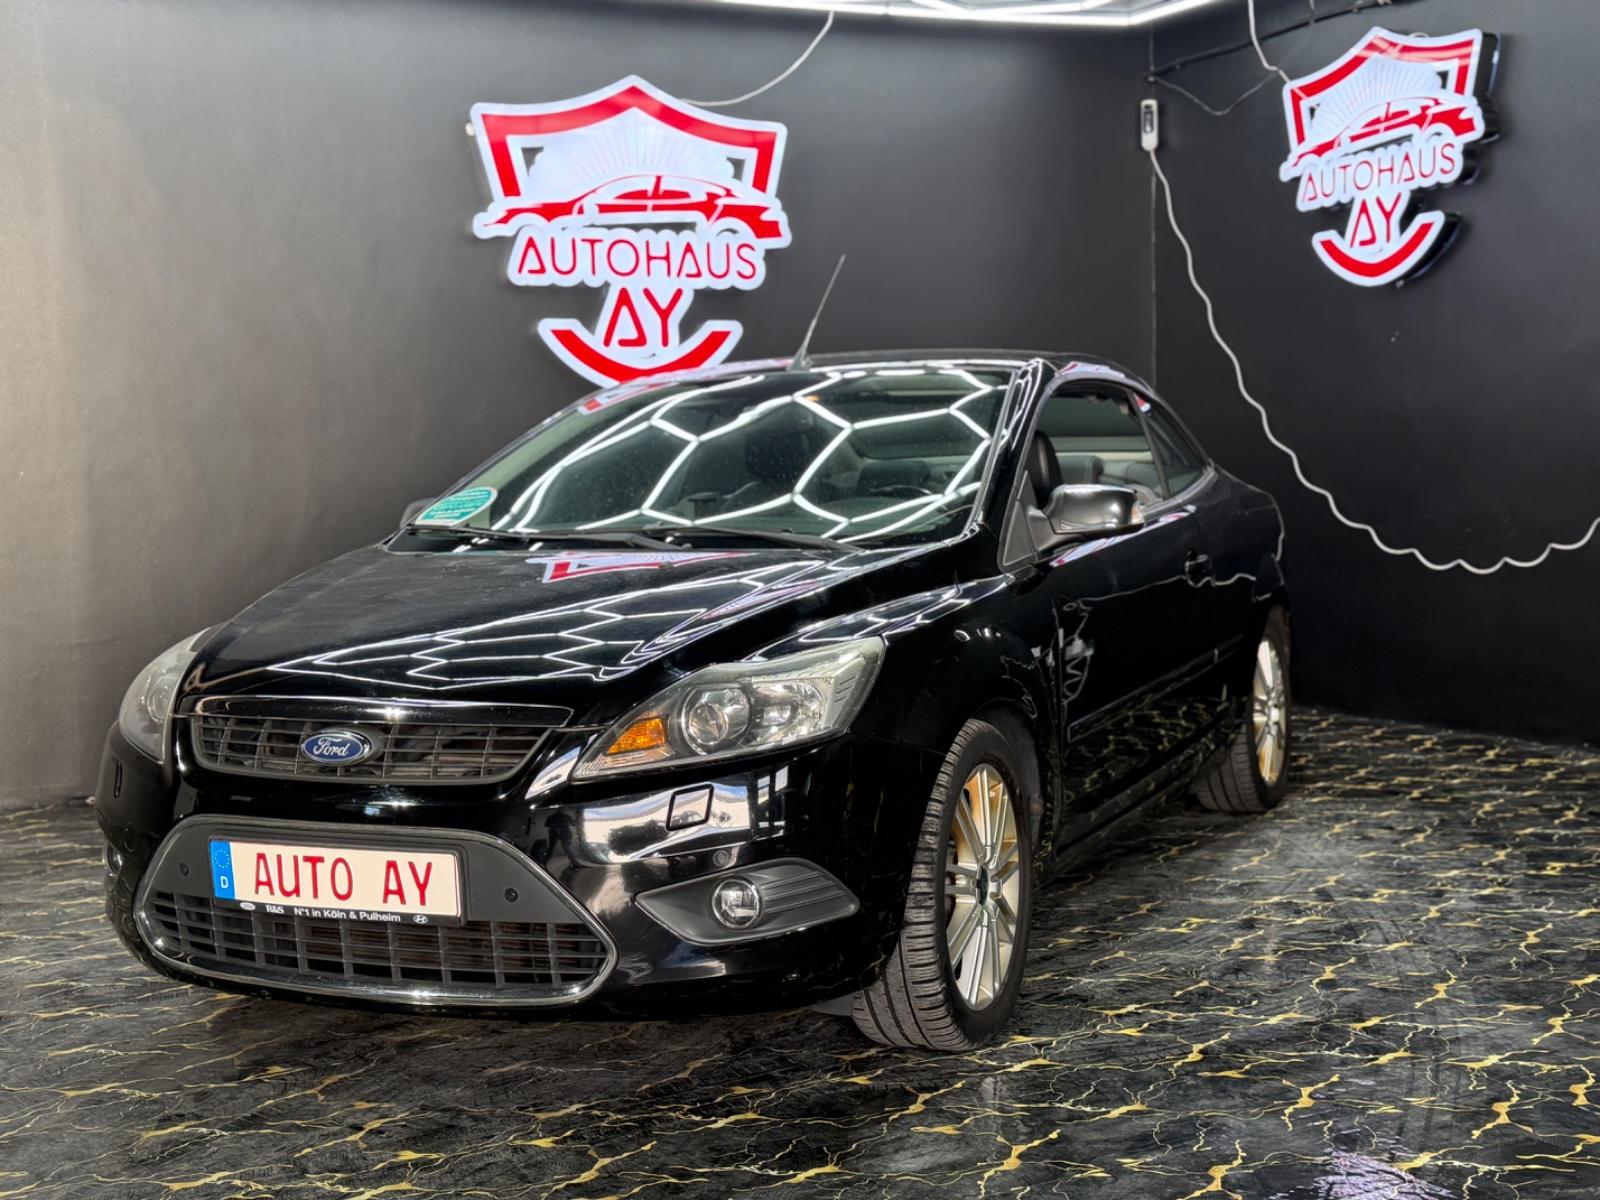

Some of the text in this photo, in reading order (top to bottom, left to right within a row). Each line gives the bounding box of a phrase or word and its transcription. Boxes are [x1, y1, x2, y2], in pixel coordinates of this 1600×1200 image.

[1301, 142, 1456, 203] AUTOHAUS
[1349, 191, 1403, 248] AY
[516, 235, 757, 280] AUTOHAUS
[602, 286, 684, 348] AY
[313, 736, 351, 757] Ford
[220, 876, 229, 889] D
[254, 852, 433, 906] AUTO AY
[312, 908, 321, 918] in
[323, 909, 347, 919] Köln
[349, 911, 358, 920] &
[359, 911, 401, 922] Pulheim
